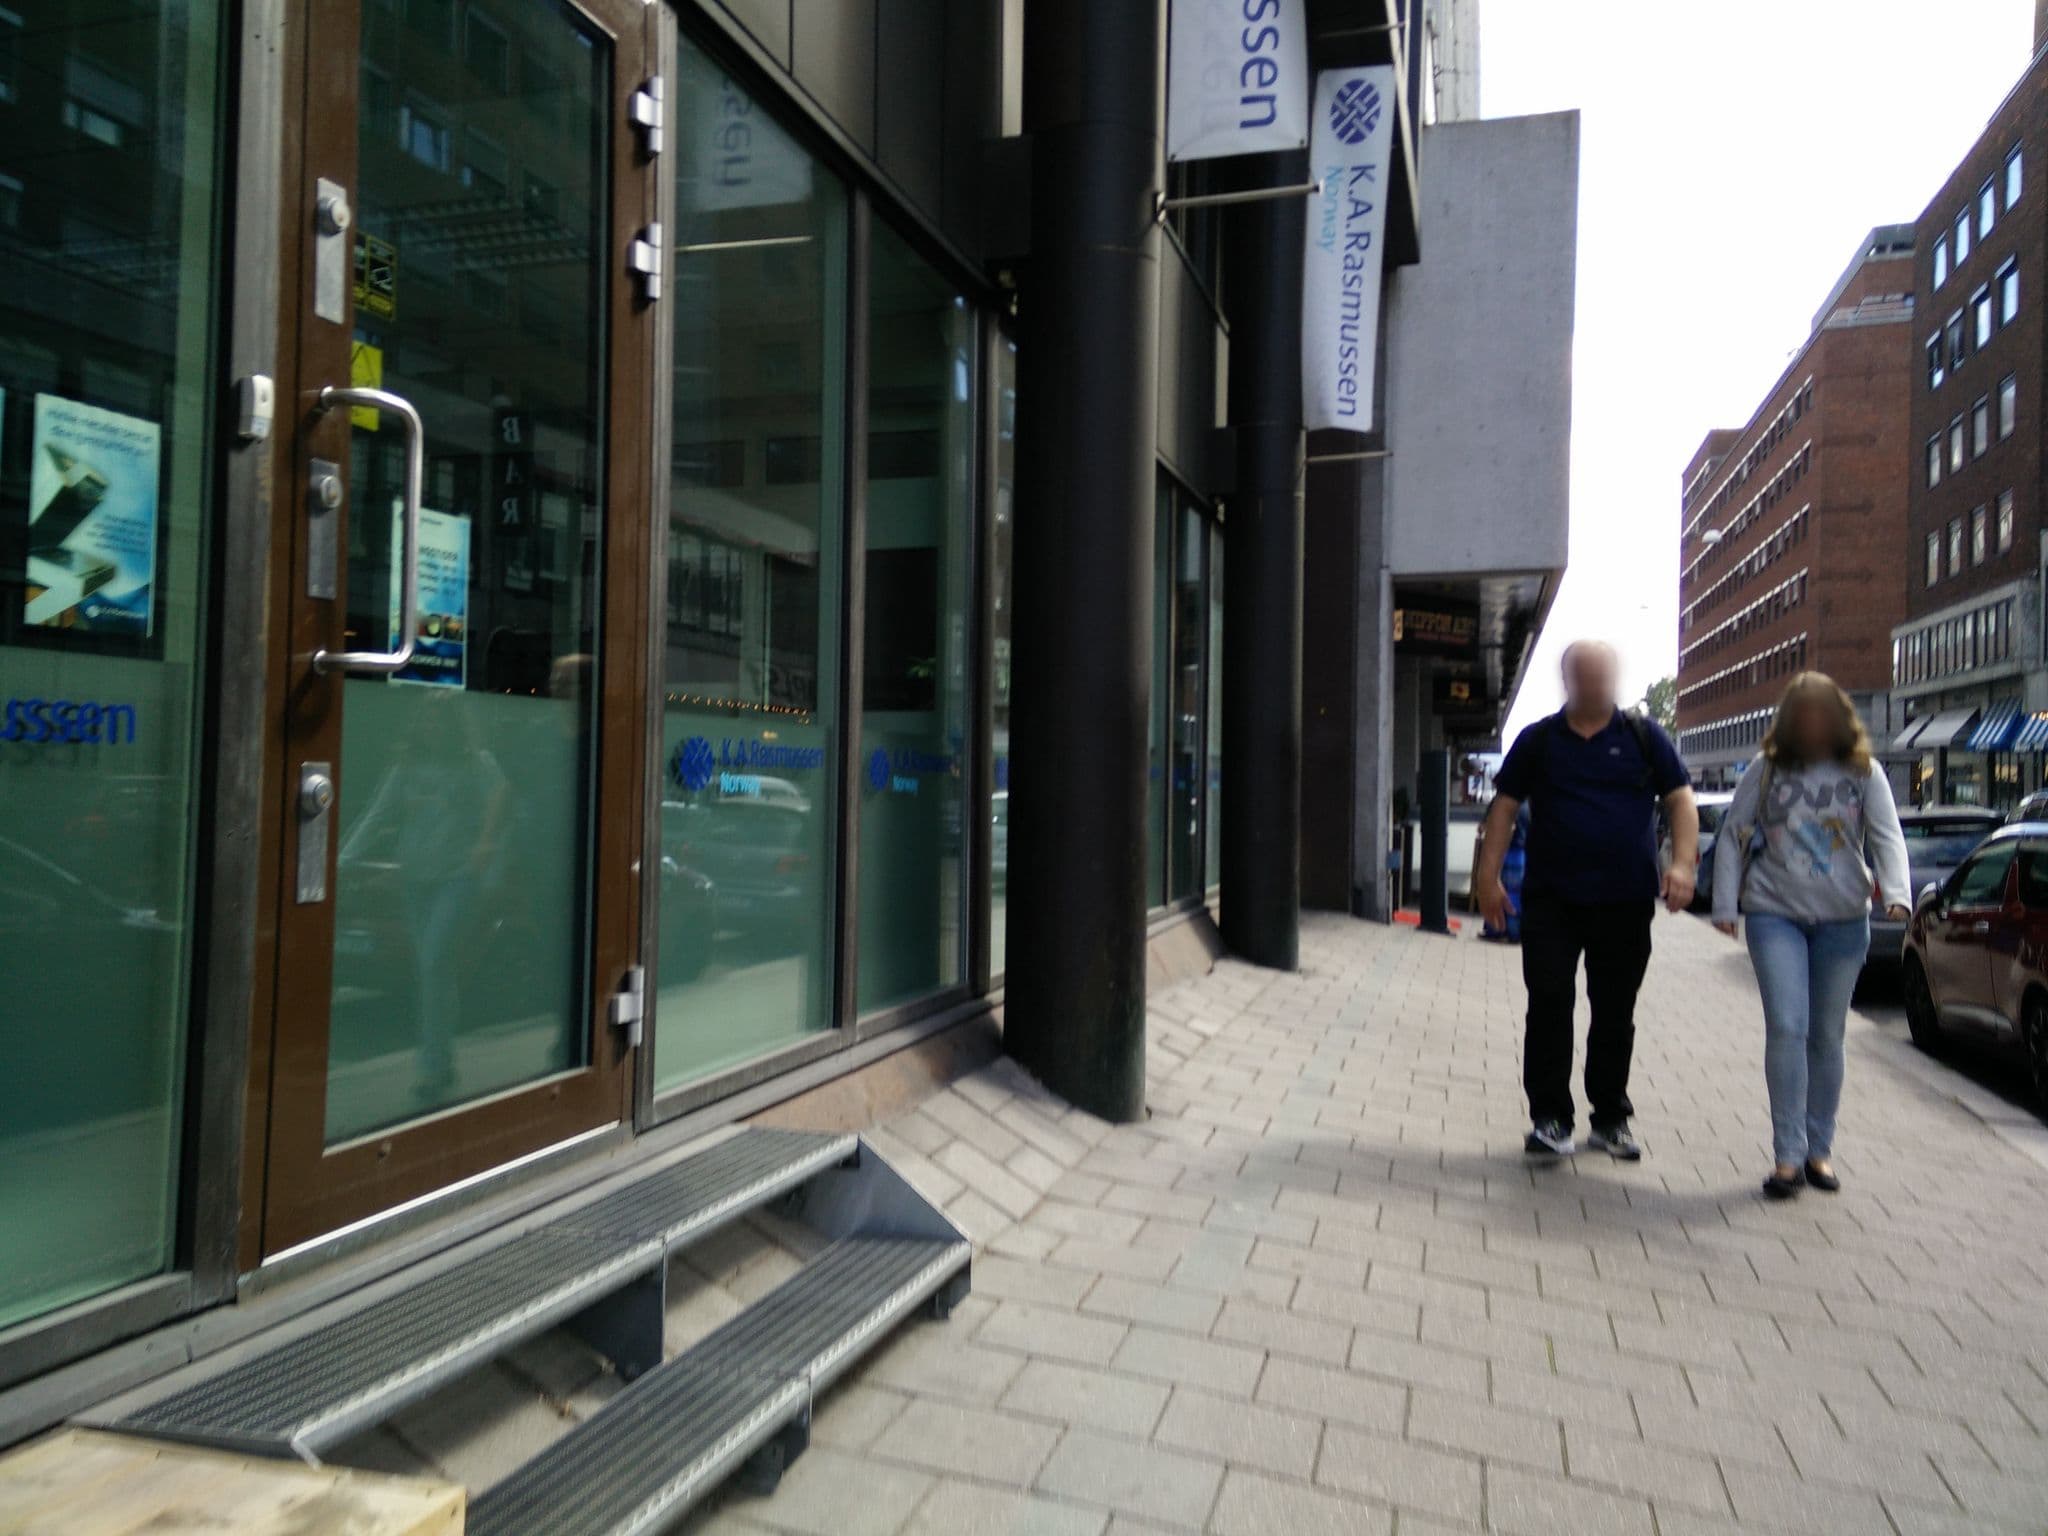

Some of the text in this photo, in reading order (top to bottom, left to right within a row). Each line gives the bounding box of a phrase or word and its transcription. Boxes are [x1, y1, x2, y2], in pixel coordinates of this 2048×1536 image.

[1315, 165, 1344, 253] Norway
[1337, 163, 1377, 418] K.A.Rasmussen
[719, 769, 761, 799] Norway
